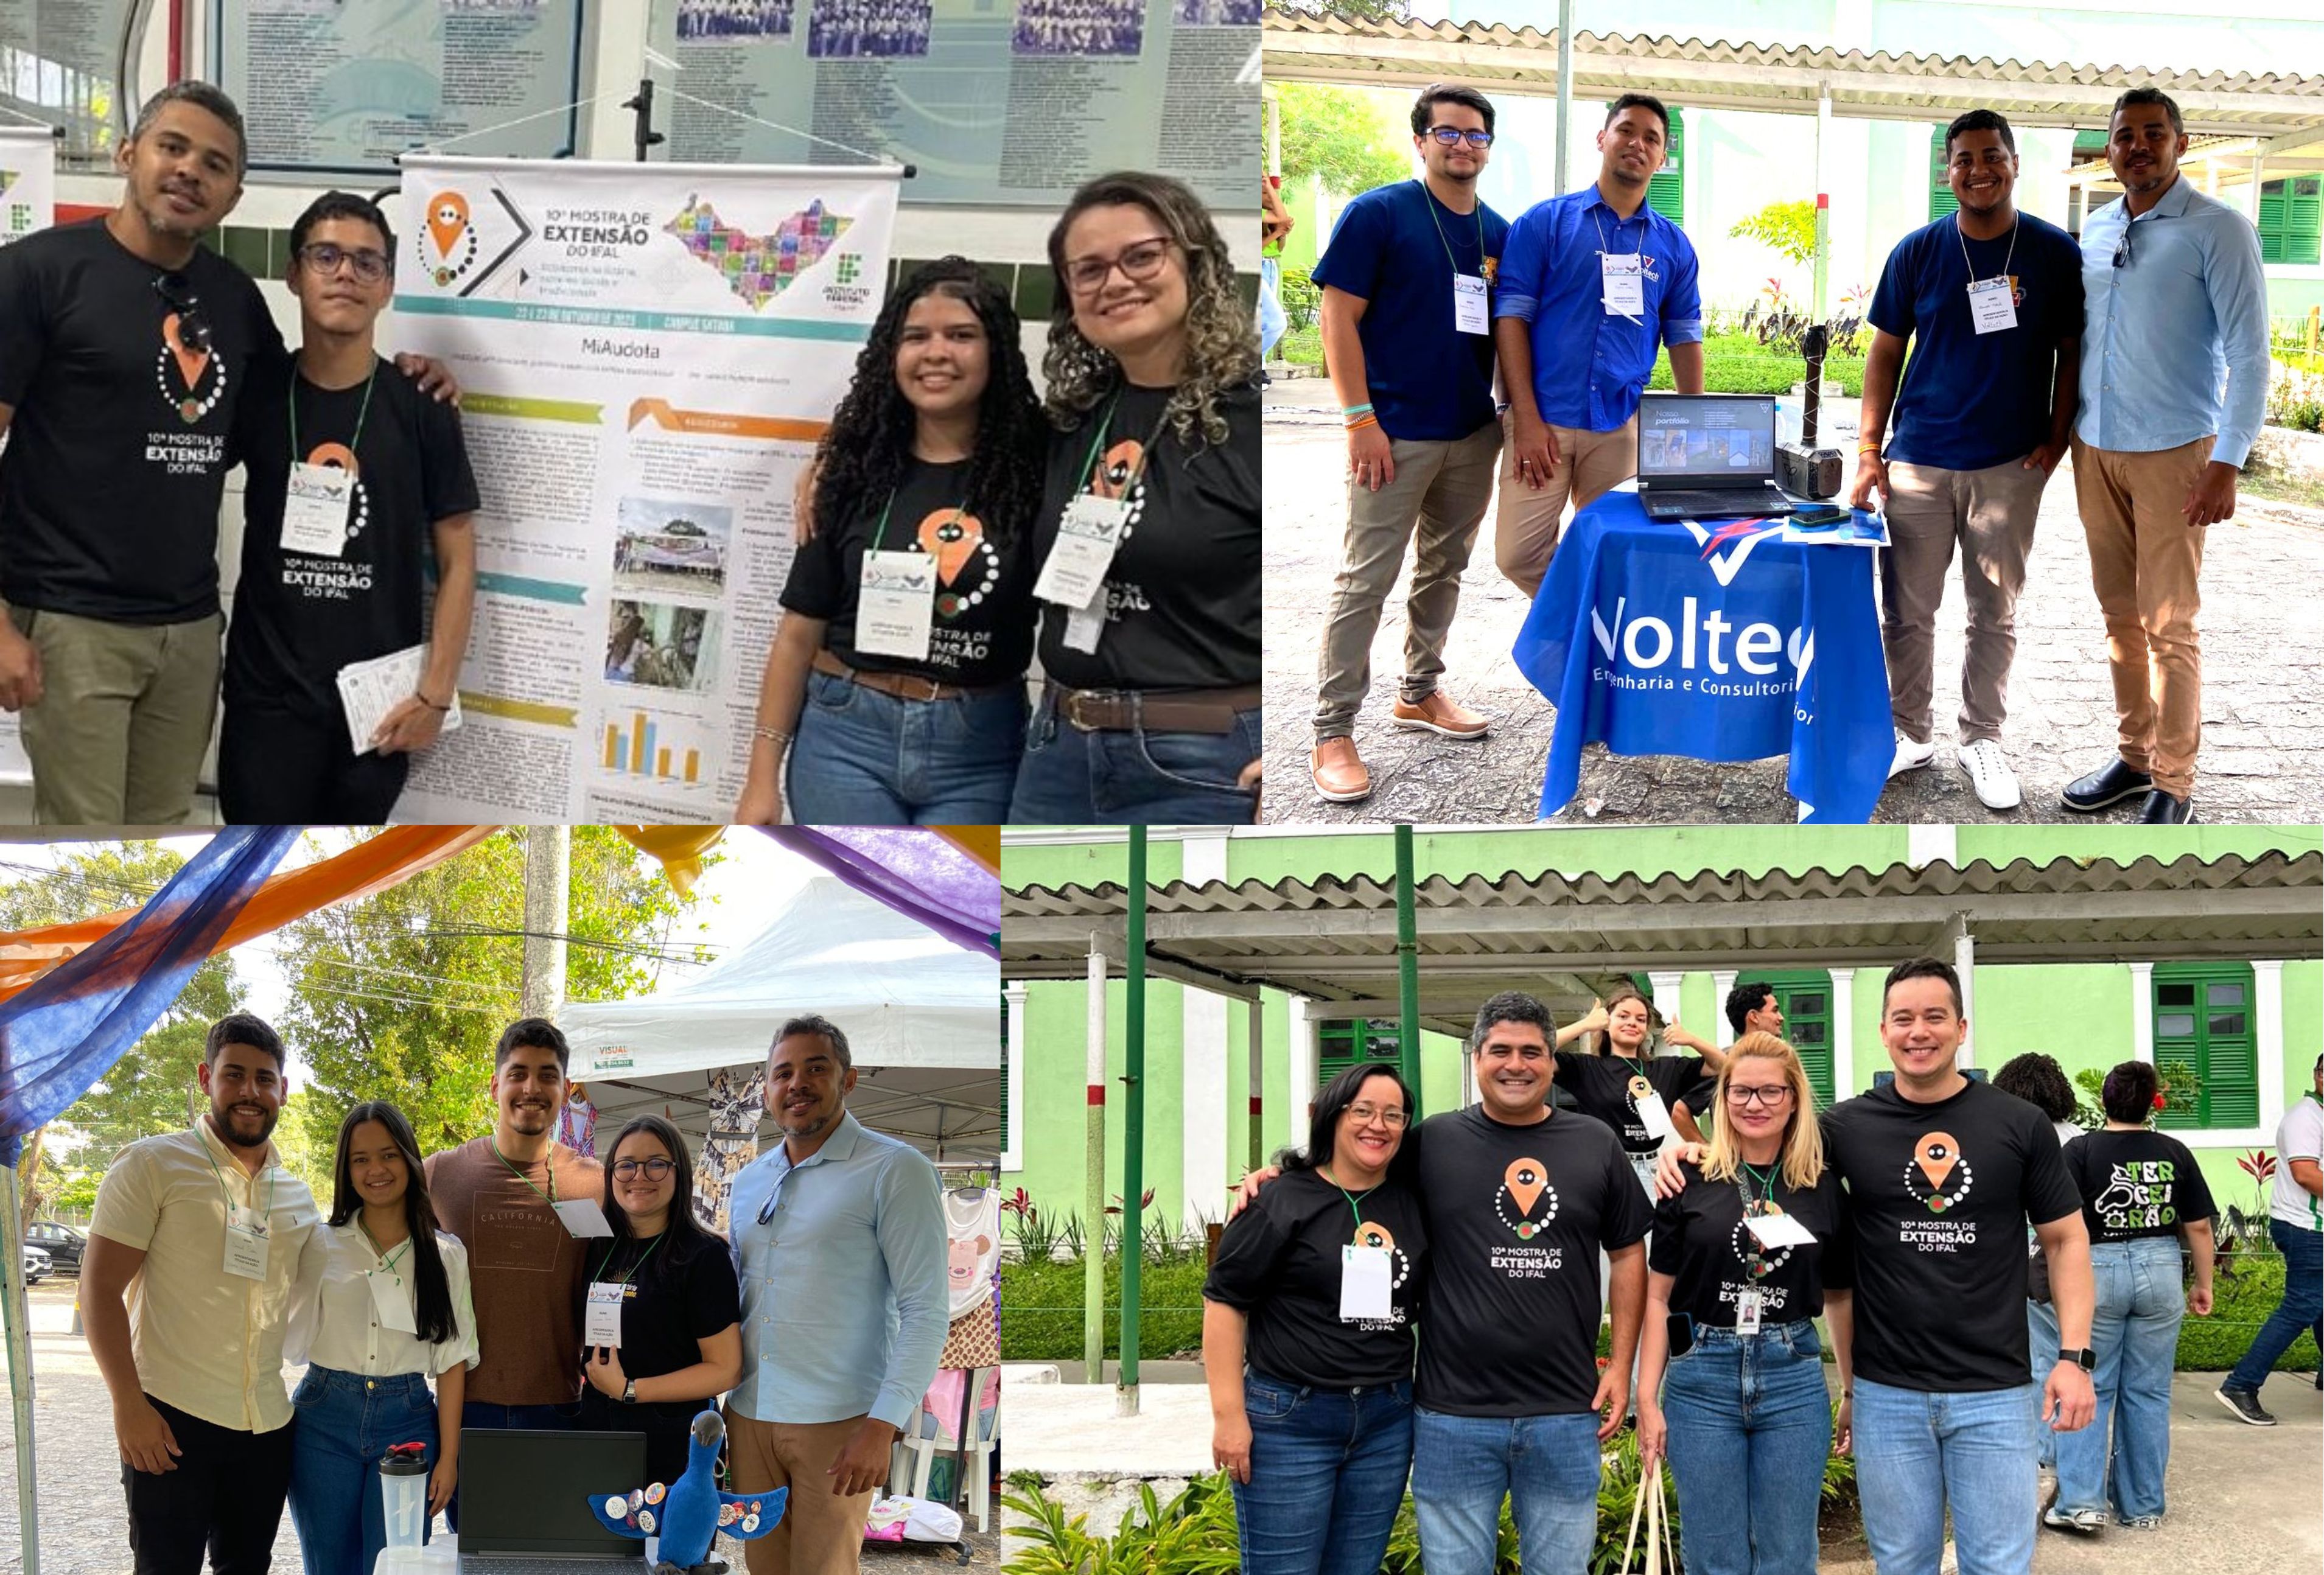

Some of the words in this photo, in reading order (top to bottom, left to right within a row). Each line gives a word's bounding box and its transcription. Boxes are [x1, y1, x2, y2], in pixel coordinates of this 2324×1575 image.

[570, 209, 627, 223] MOSTRA
[631, 212, 650, 226] DE
[544, 225, 649, 245] EXTENSÃO
[566, 245, 587, 257] DO
[590, 245, 620, 259] IFAL
[581, 338, 659, 358] MiAudota
[169, 433, 211, 445] MOSTRA
[146, 445, 222, 461] EXTENSÃO
[167, 462, 184, 473] DO
[186, 463, 208, 473] IFAL
[304, 559, 353, 573] MOSTRA
[356, 564, 373, 575] DE
[282, 570, 371, 590] EXTENSÃO
[304, 585, 321, 597] DO
[324, 587, 349, 599] IFAL
[973, 630, 991, 641] DE
[1683, 679, 1693, 690] e
[599, 1044, 628, 1055] VISUAL
[2127, 1161, 2175, 1182] TER
[481, 1212, 555, 1226] CALIFORNIA
[2129, 1204, 2175, 1229] RÃO
[1918, 1221, 1959, 1230] MOSTRA
[1962, 1223, 1976, 1231] DE
[1900, 1230, 1976, 1243] EXTENSÃO
[1508, 1248, 1547, 1256] MOSTRA
[1549, 1248, 1563, 1257] DE
[1919, 1243, 1933, 1252] DO
[1936, 1244, 1957, 1252] IFAL
[1491, 1255, 1561, 1269] EXTENSÃO
[1509, 1269, 1523, 1278] DO
[1721, 1281, 1735, 1290] 10ª
[1776, 1287, 1788, 1297] DE
[1393, 1306, 1405, 1315] DE
